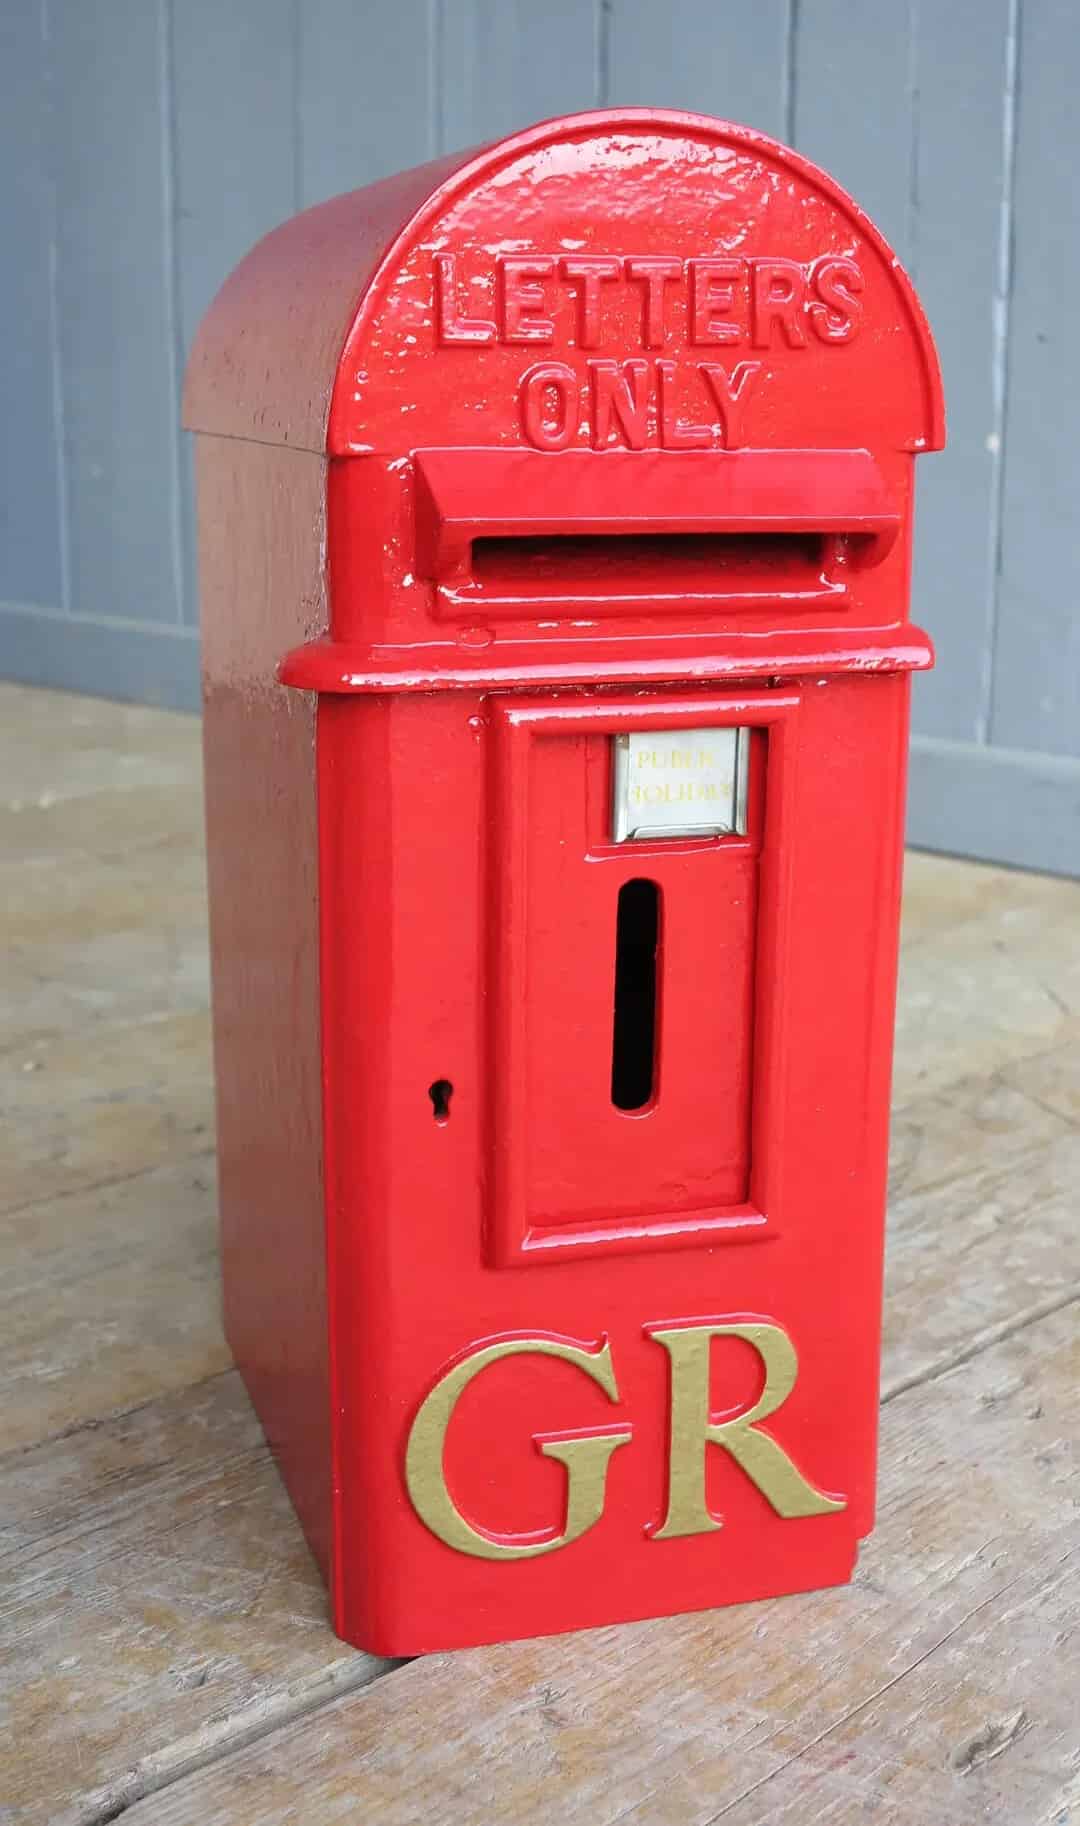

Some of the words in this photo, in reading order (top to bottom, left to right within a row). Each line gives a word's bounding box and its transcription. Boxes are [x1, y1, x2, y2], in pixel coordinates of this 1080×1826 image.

[432, 252, 865, 350] LETTERS
[518, 357, 761, 451] ONLY
[404, 1315, 849, 1561] GR
